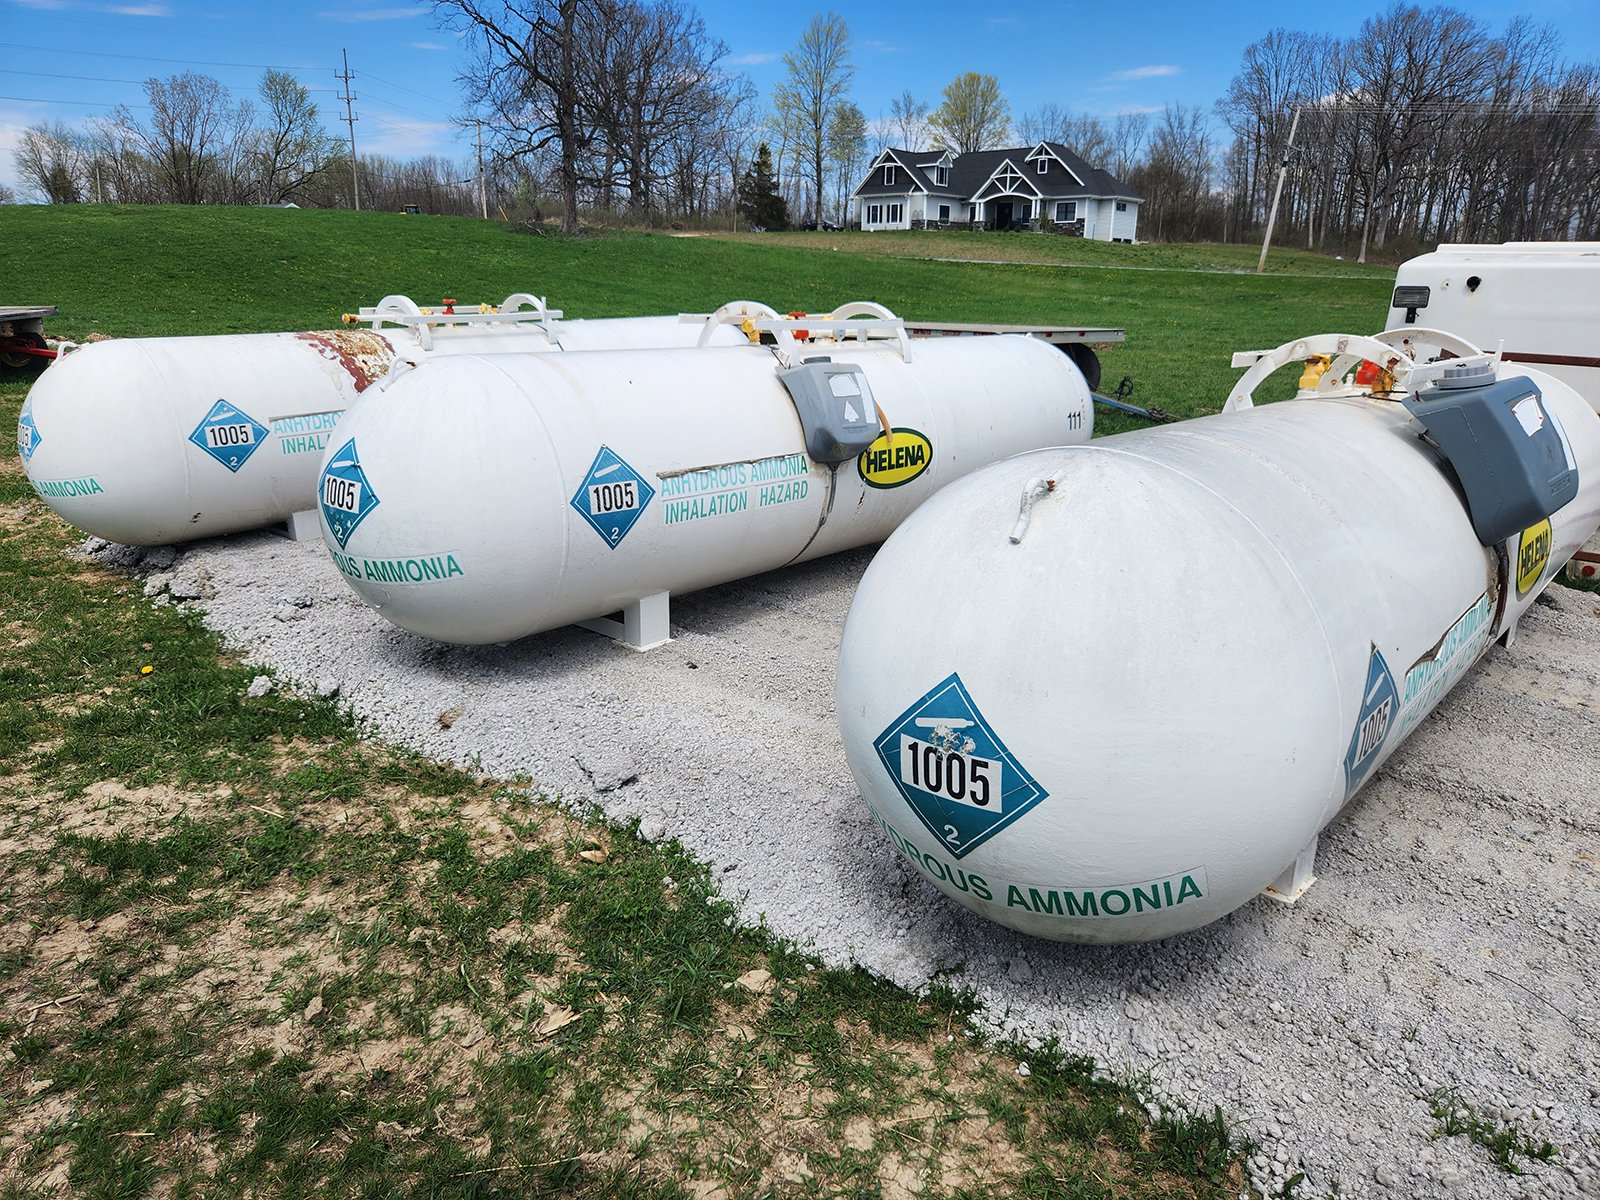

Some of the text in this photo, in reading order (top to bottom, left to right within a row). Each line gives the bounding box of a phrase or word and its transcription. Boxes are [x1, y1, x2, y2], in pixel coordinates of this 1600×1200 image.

[1067, 411, 1081, 430] 111
[210, 425, 249, 446] 1005
[230, 457, 238, 466] 2
[866, 444, 925, 474] HELENA
[40, 478, 104, 497] AMMONIA
[661, 455, 808, 497] ANHYDROUS AMMONIA
[326, 477, 356, 511] 1005
[593, 483, 634, 512] 1005
[665, 480, 808, 525] INHALATION HAZARD
[611, 527, 619, 540] 2
[363, 554, 464, 582] AMMONIA
[1520, 528, 1549, 579] HELENA
[1358, 700, 1389, 762] 1005
[908, 741, 990, 807] 1005
[943, 824, 960, 845] 2
[1007, 875, 1203, 916] AMMONIA
